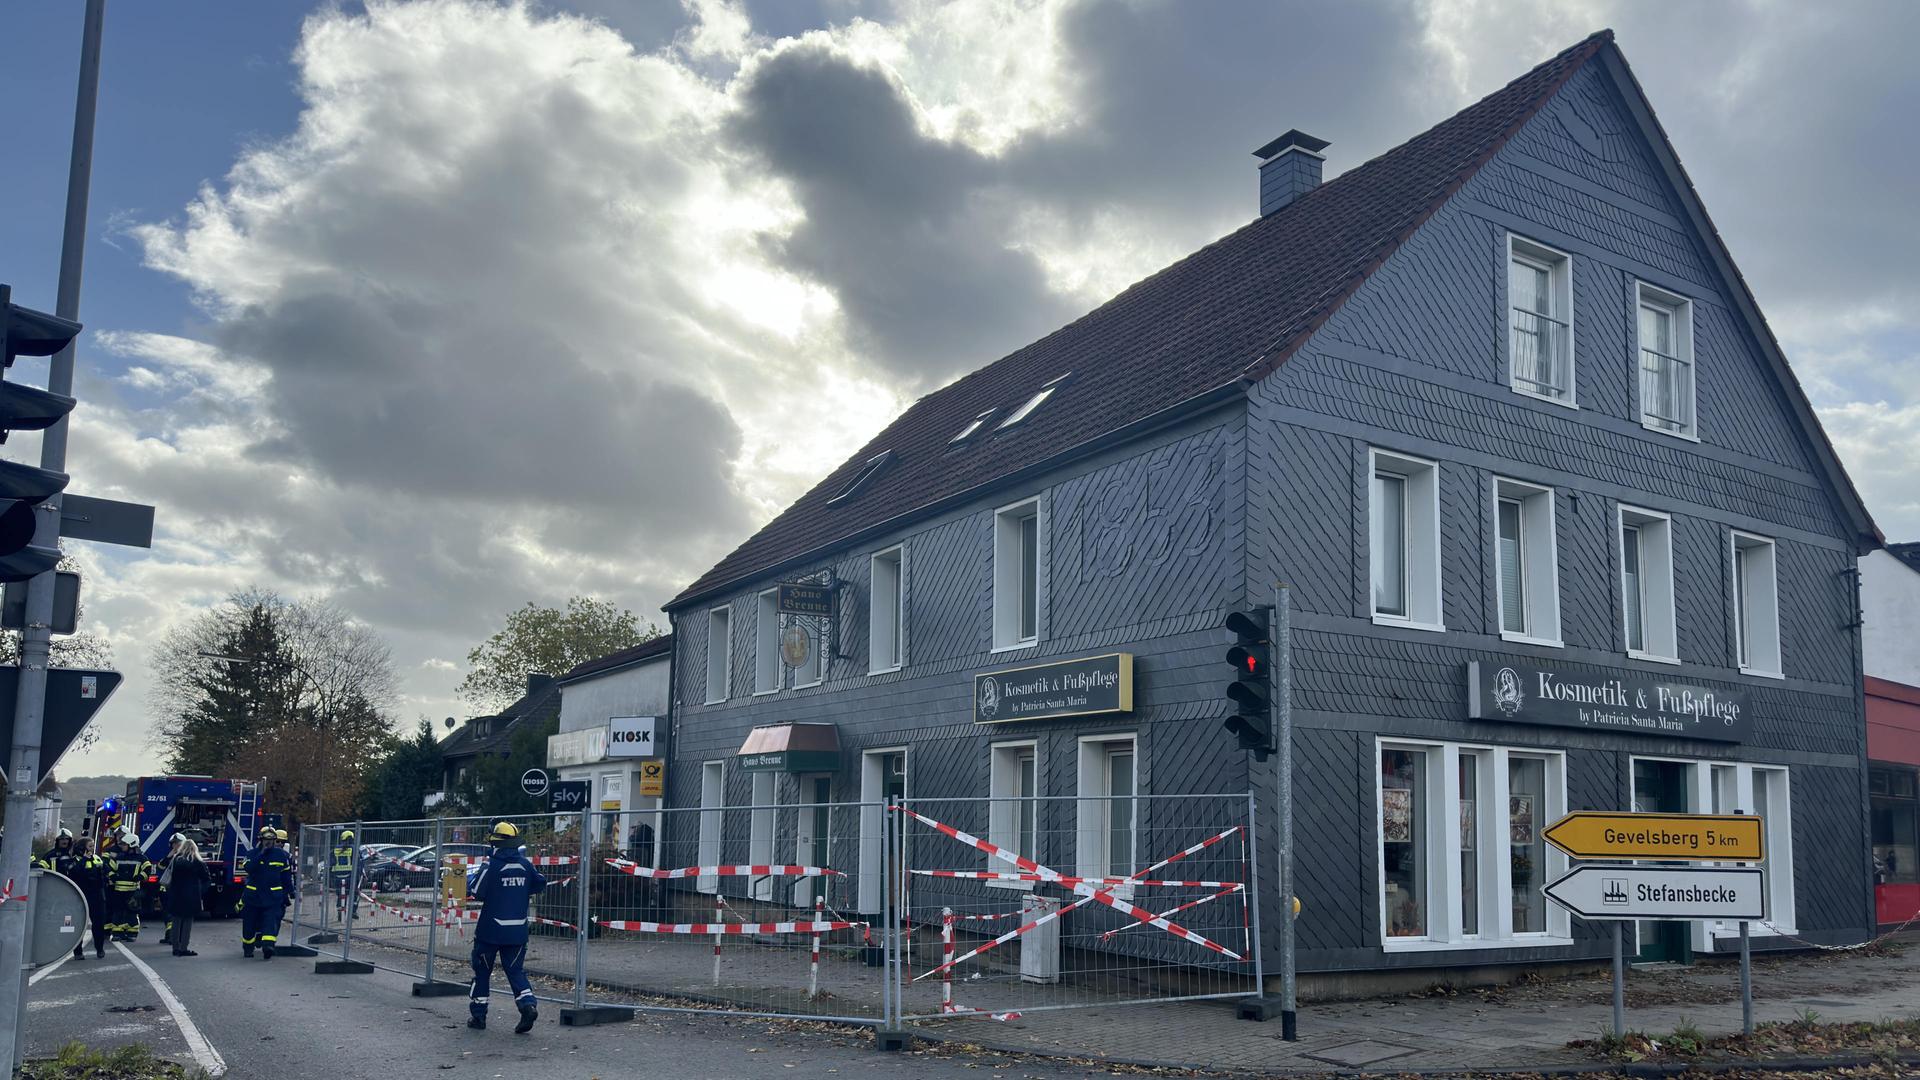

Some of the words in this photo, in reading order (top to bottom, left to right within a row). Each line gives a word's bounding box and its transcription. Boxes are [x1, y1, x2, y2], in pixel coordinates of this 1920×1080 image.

[1005, 677, 1049, 698] Kosmetik
[1052, 679, 1060, 691] &
[1063, 669, 1118, 693] Fußpflege
[1012, 703, 1020, 714] by
[1021, 701, 1046, 712] Patricia
[1046, 698, 1065, 709] Santa
[1066, 695, 1087, 707] Maria
[1536, 671, 1629, 708] Kosmetik
[1635, 688, 1648, 710] &
[1656, 686, 1741, 727] Fußpflege
[1579, 708, 1590, 726] by
[1593, 709, 1629, 726] Patricia
[1631, 714, 1656, 729] Santa
[1658, 716, 1683, 731] Maria
[612, 730, 650, 743] KIOSK
[742, 756, 759, 768] Haus
[759, 755, 782, 766] Brenne
[553, 788, 581, 805] sky
[1604, 828, 1699, 849] Gevelsberg
[1706, 831, 1715, 846] 5
[1719, 832, 1739, 846] km
[501, 876, 526, 887] THW
[1637, 883, 1737, 903] Stefansbecke
